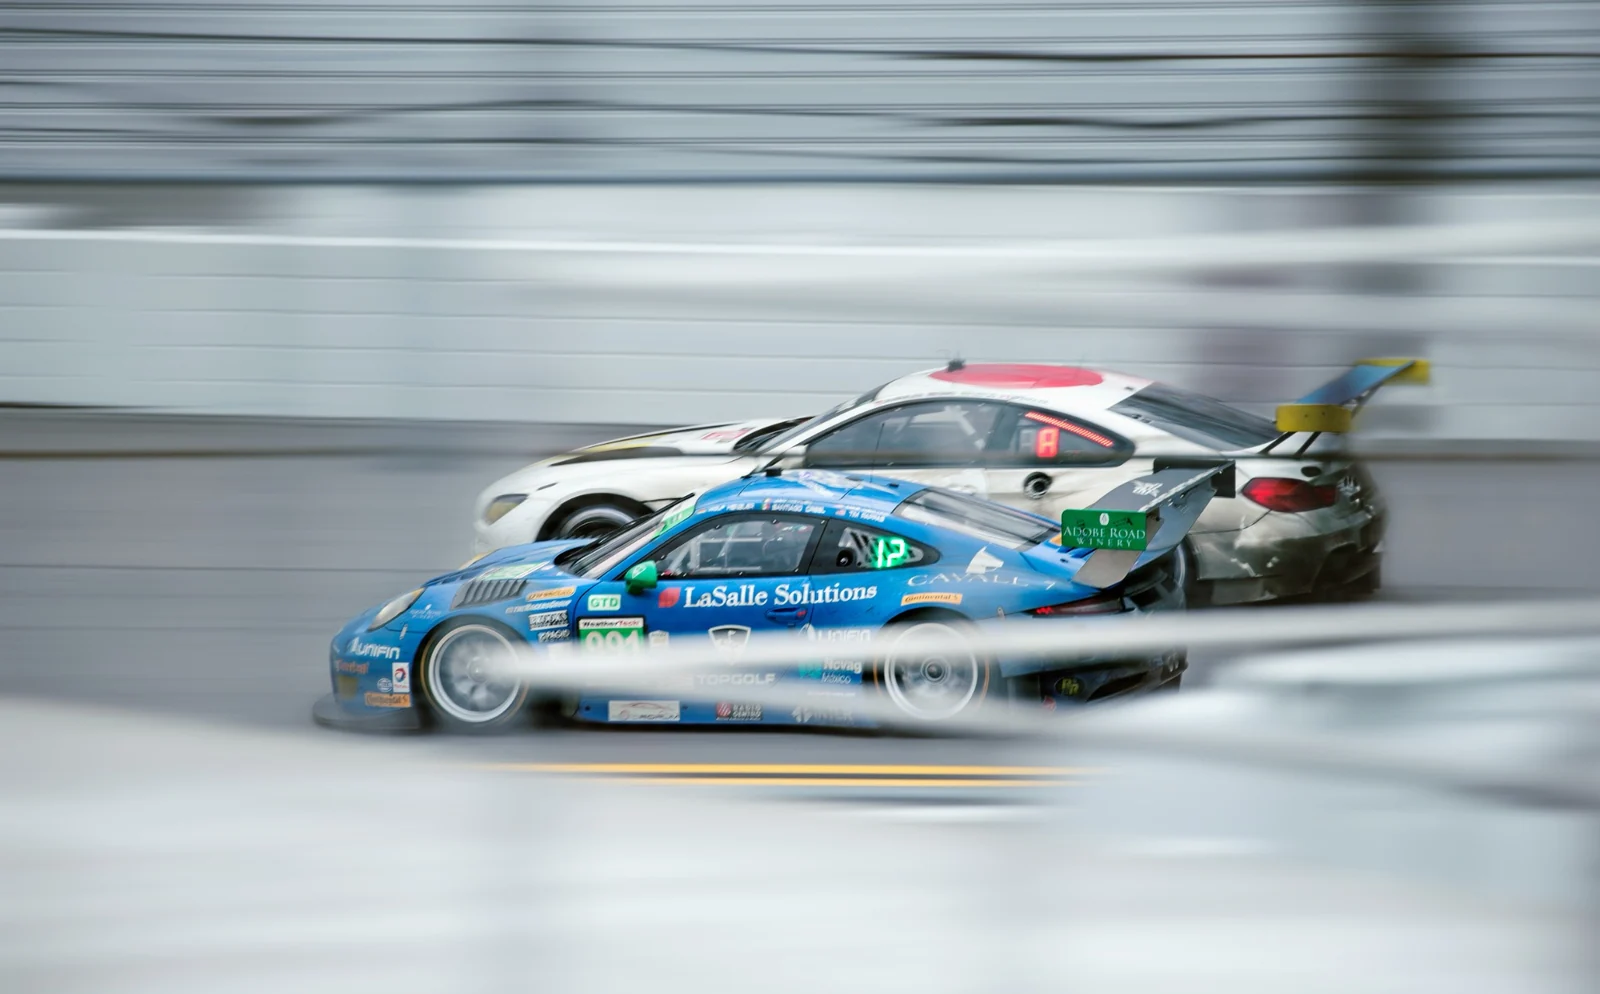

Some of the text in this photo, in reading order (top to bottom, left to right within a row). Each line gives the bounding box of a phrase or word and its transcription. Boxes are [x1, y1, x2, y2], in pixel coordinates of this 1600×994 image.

[1063, 525, 1146, 540] ADOBE ROAD
[1076, 538, 1133, 548] WINERY
[877, 538, 905, 568] 12
[683, 582, 878, 608] LaSalle Solutions
[590, 597, 619, 608] GTD
[697, 672, 776, 686] TOPGOLF
